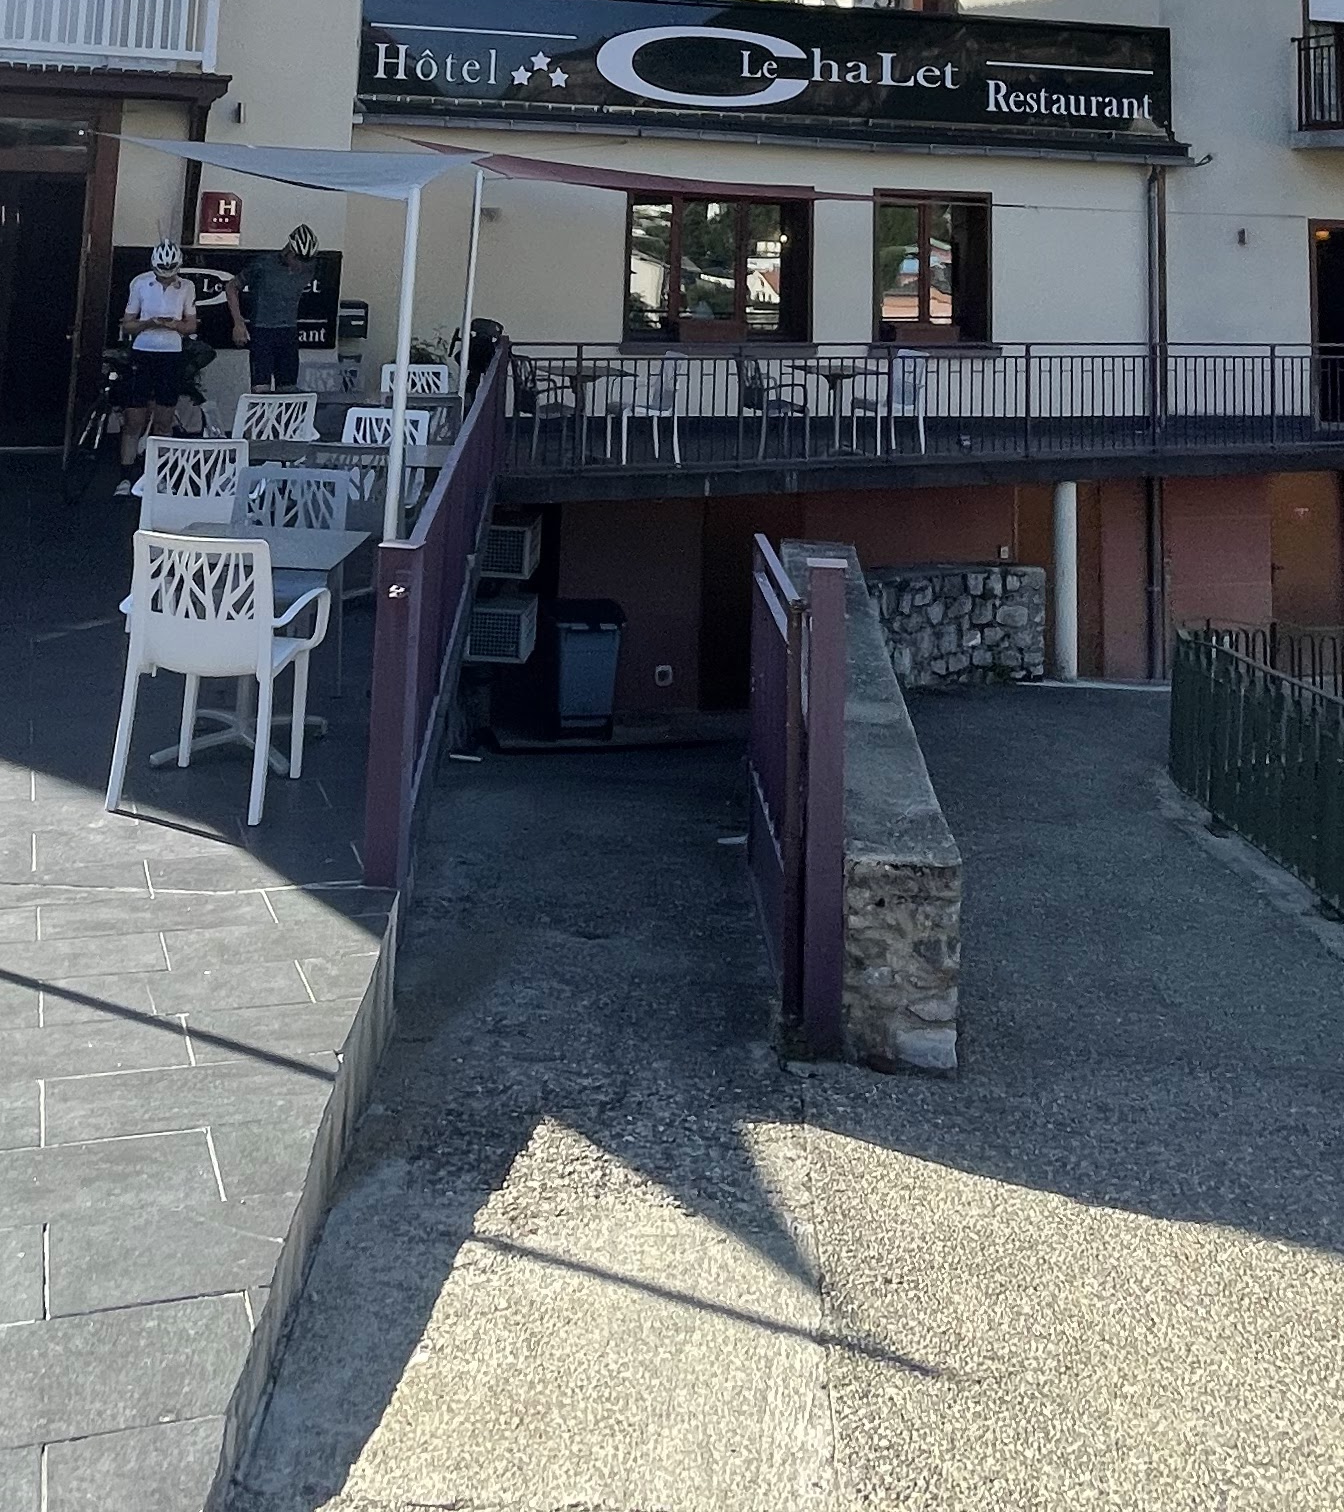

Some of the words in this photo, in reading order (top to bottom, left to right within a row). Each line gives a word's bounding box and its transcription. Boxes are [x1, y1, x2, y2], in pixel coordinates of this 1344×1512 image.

[373, 42, 498, 85] Hôtel
[740, 50, 778, 79] Le
[985, 79, 1152, 119] Restaurant
[218, 199, 236, 216] H
